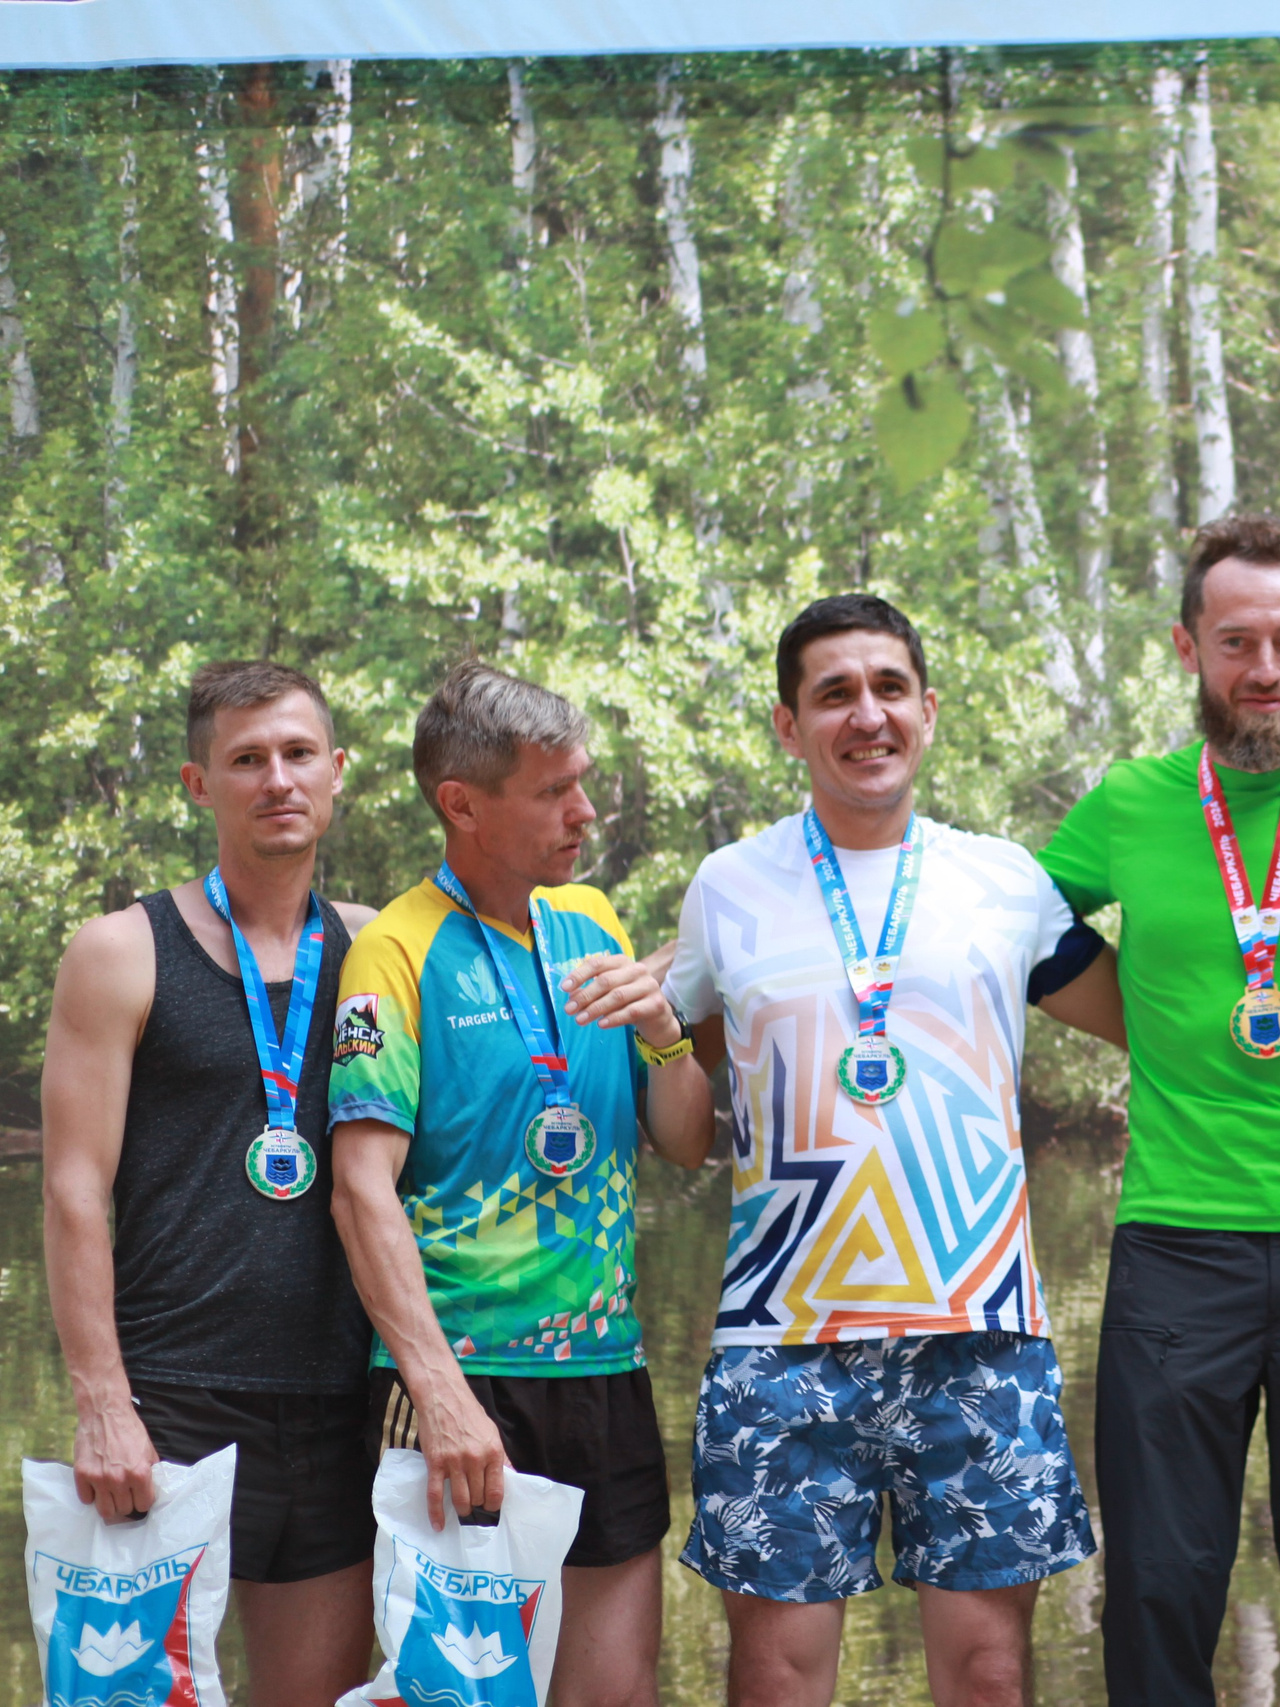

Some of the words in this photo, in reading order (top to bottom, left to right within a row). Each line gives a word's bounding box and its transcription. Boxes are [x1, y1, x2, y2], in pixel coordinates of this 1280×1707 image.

[820, 857, 837, 882] 2024
[1220, 834, 1246, 907] ЧЕБАРКУЛЬ
[830, 887, 858, 957] ЧЕБАРКУЛЬ
[883, 884, 909, 951] ЧЕБАРКУЛЬ
[56, 1558, 192, 1600] ЧЕБАРКУЛЬ
